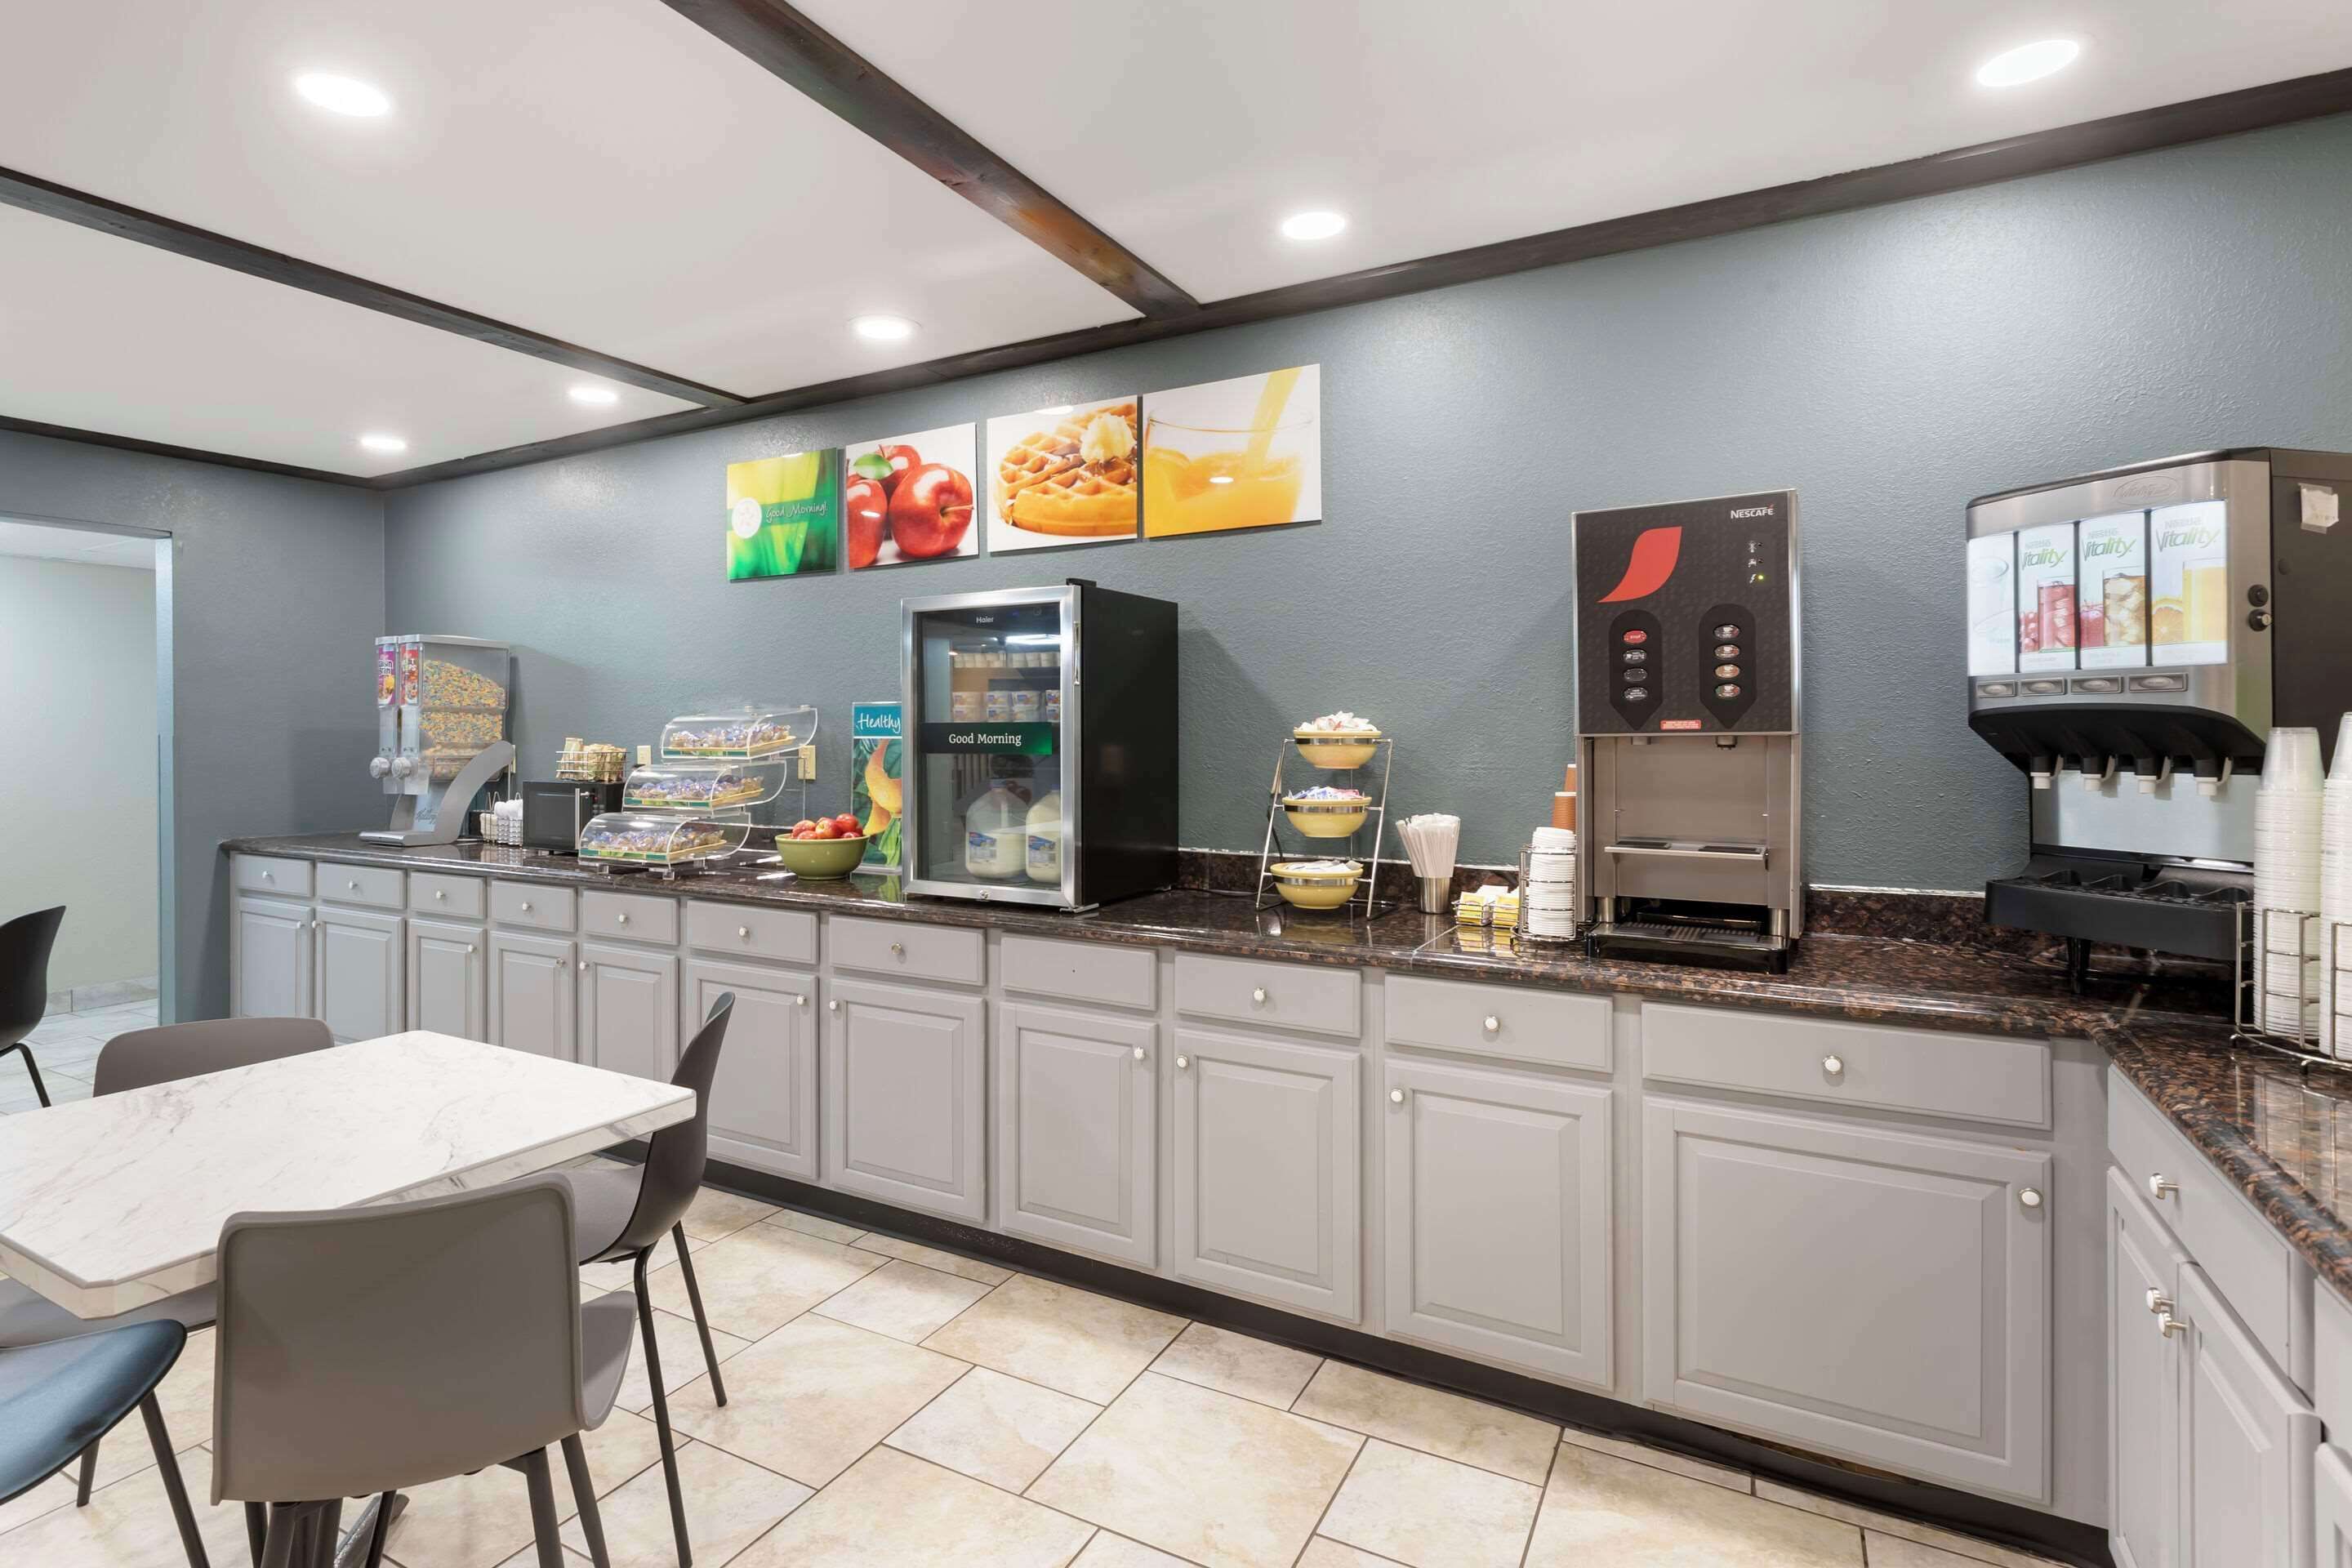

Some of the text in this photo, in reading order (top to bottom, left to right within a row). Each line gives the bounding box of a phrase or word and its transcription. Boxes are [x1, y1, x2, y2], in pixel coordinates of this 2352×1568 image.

[766, 501, 828, 523] Good Morning!
[2082, 537, 2136, 562] Vitality
[2155, 527, 2221, 553] Vitality
[2020, 548, 2068, 571] Vitality
[976, 615, 994, 624] Haier
[857, 712, 902, 734] Healthy
[948, 732, 1022, 746] Good Morning
